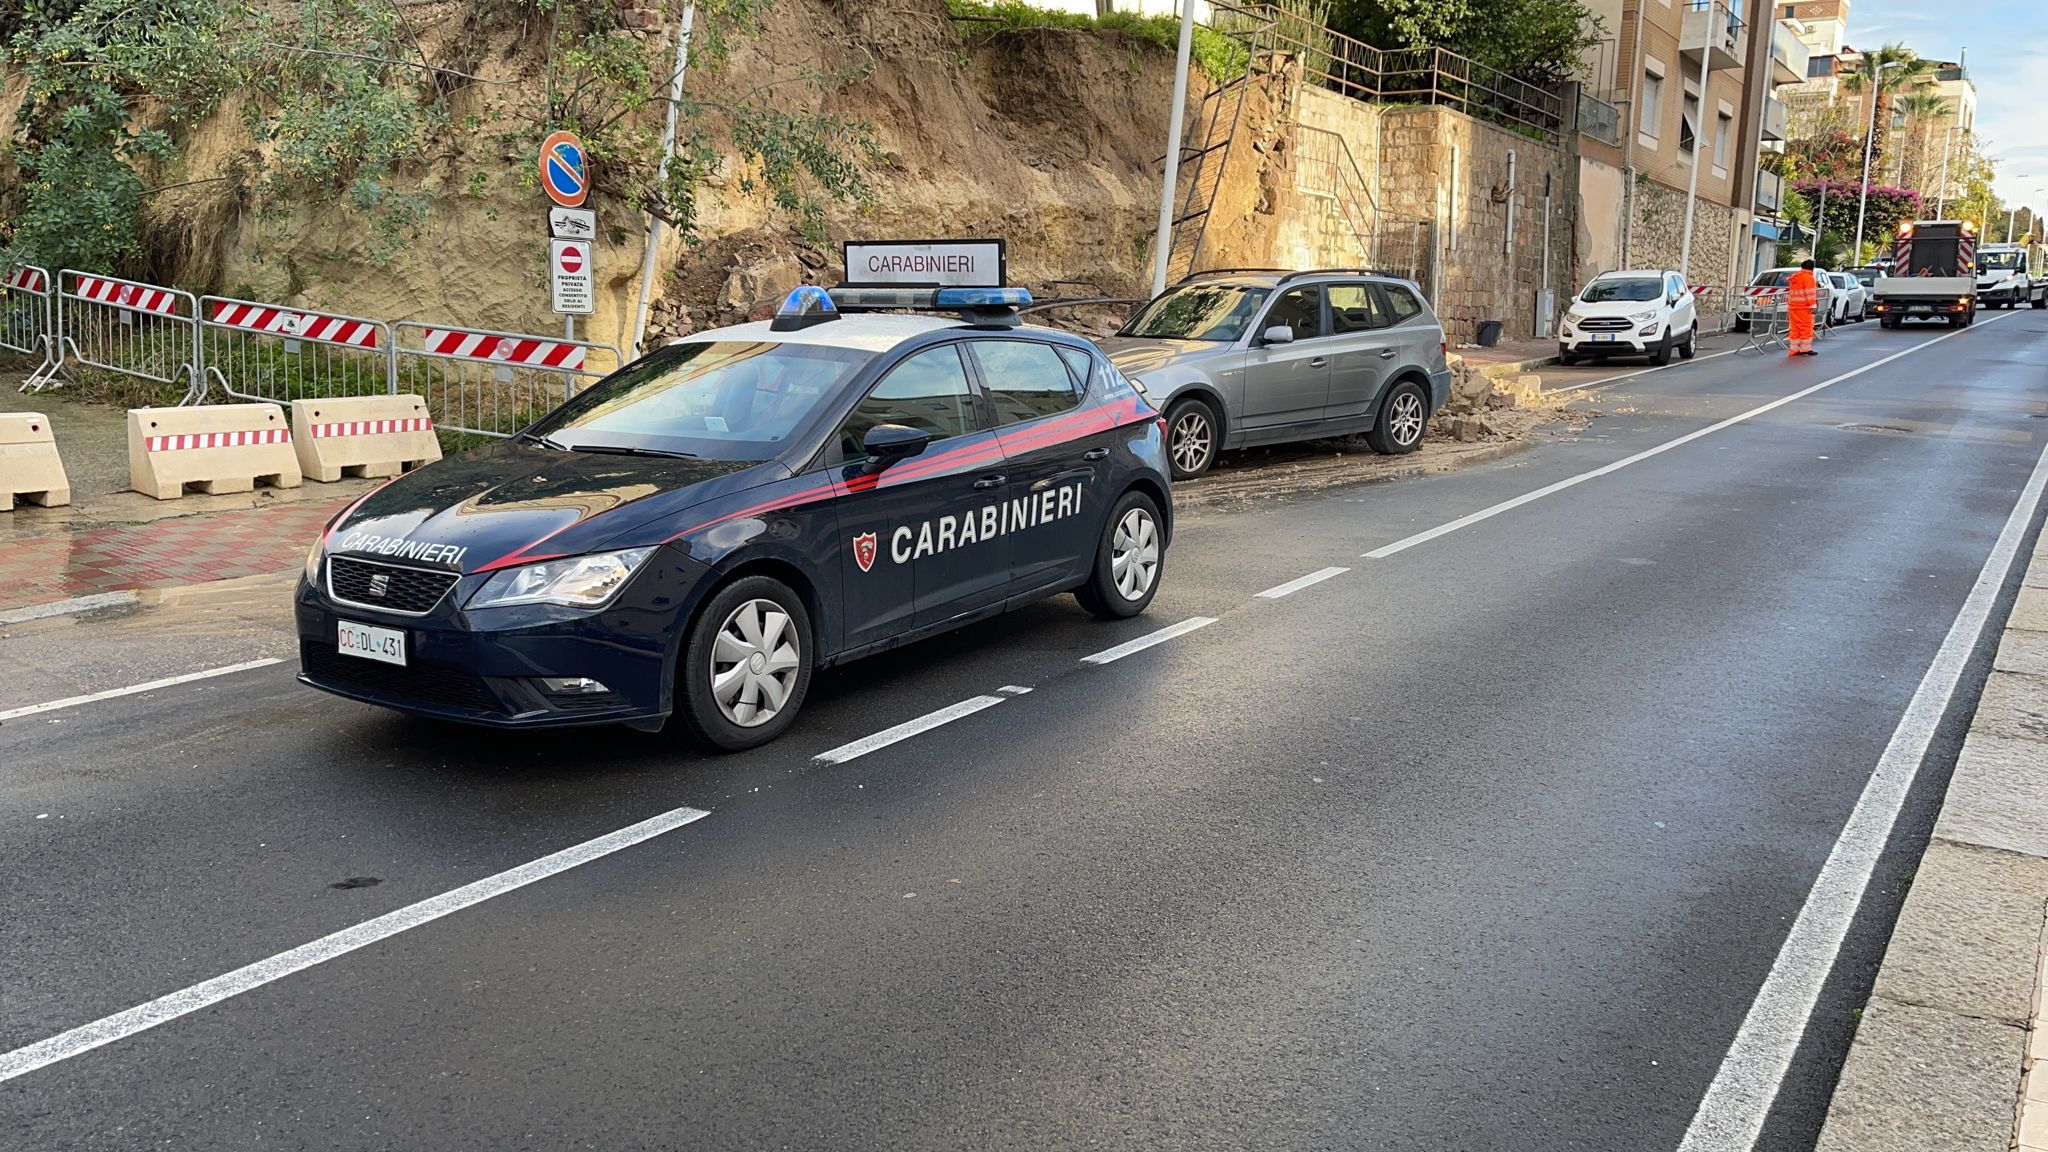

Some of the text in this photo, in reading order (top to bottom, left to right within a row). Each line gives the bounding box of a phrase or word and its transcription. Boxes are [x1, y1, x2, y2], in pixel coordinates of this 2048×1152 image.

[868, 254, 976, 274] CARABINIERI
[891, 482, 1083, 565] CARABINIERI
[342, 531, 468, 565] CARABINIERI
